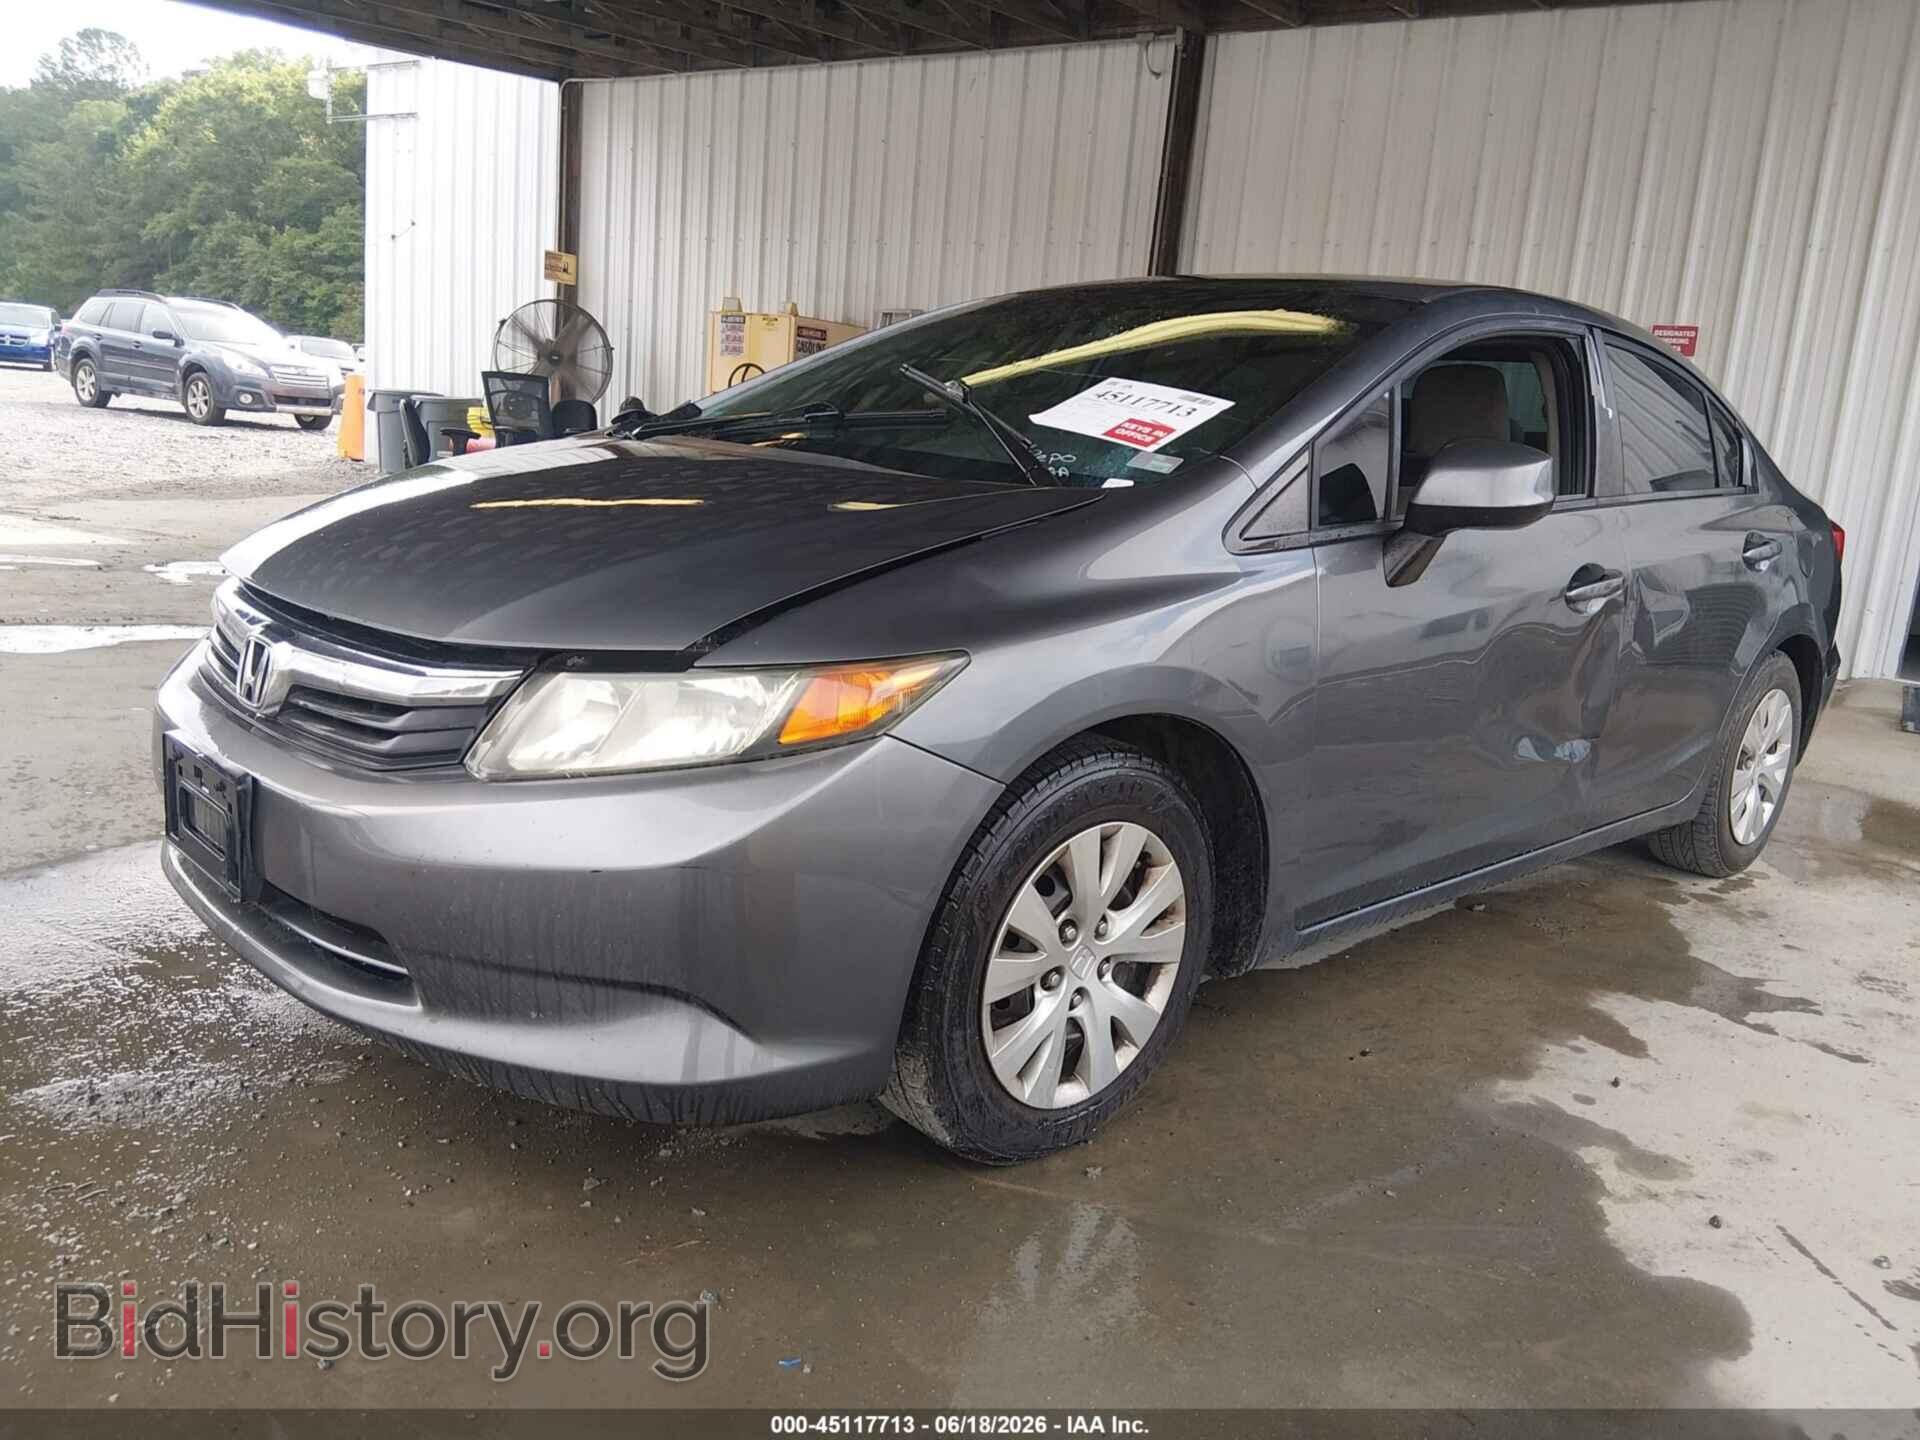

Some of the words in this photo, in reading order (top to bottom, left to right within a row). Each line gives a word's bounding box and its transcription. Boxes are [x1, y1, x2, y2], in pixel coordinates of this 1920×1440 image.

[1654, 329, 1696, 337] DESIGNATED
[1663, 337, 1689, 345] MOKING
[1095, 390, 1198, 417] 45117713
[1114, 428, 1156, 442] OFFICE
[1120, 421, 1150, 435] KEYS
[1152, 429, 1169, 438] IN
